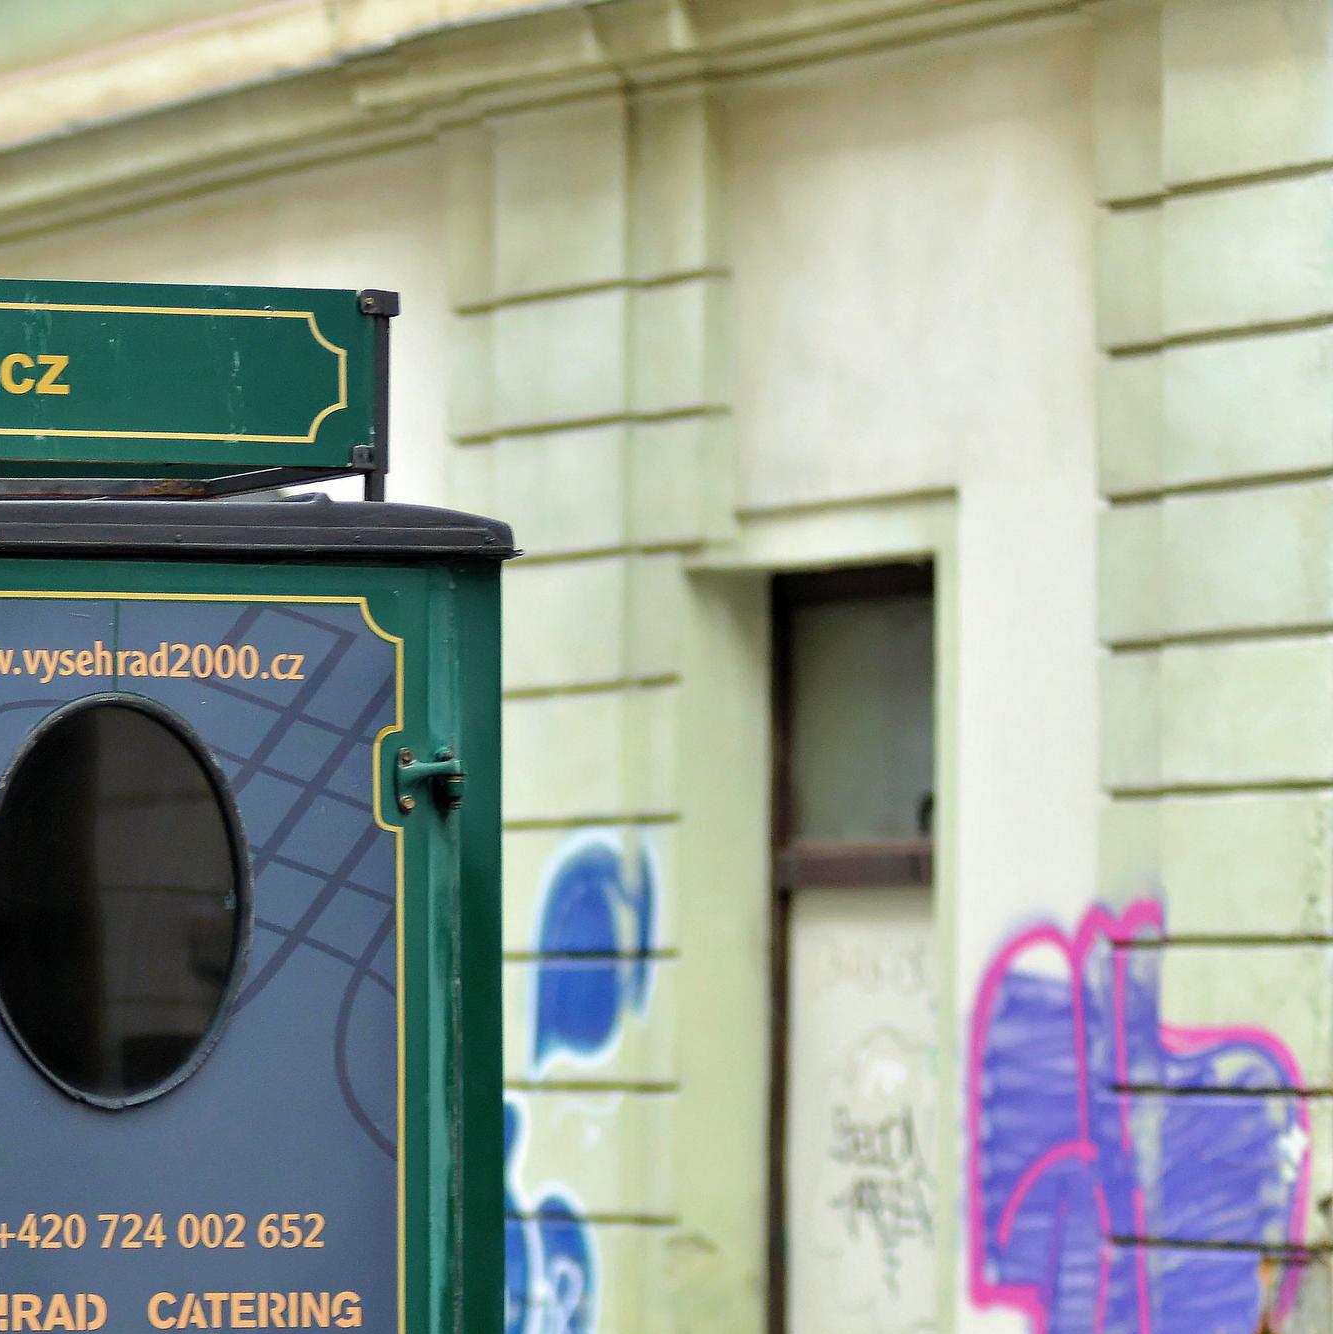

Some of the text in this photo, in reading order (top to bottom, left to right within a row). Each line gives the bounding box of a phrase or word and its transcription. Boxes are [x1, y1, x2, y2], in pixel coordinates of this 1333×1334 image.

[98, 1213, 165, 1248] 724
[177, 1213, 245, 1248] 002
[258, 1213, 325, 1248] 652
[148, 1291, 362, 1329] CATERING
